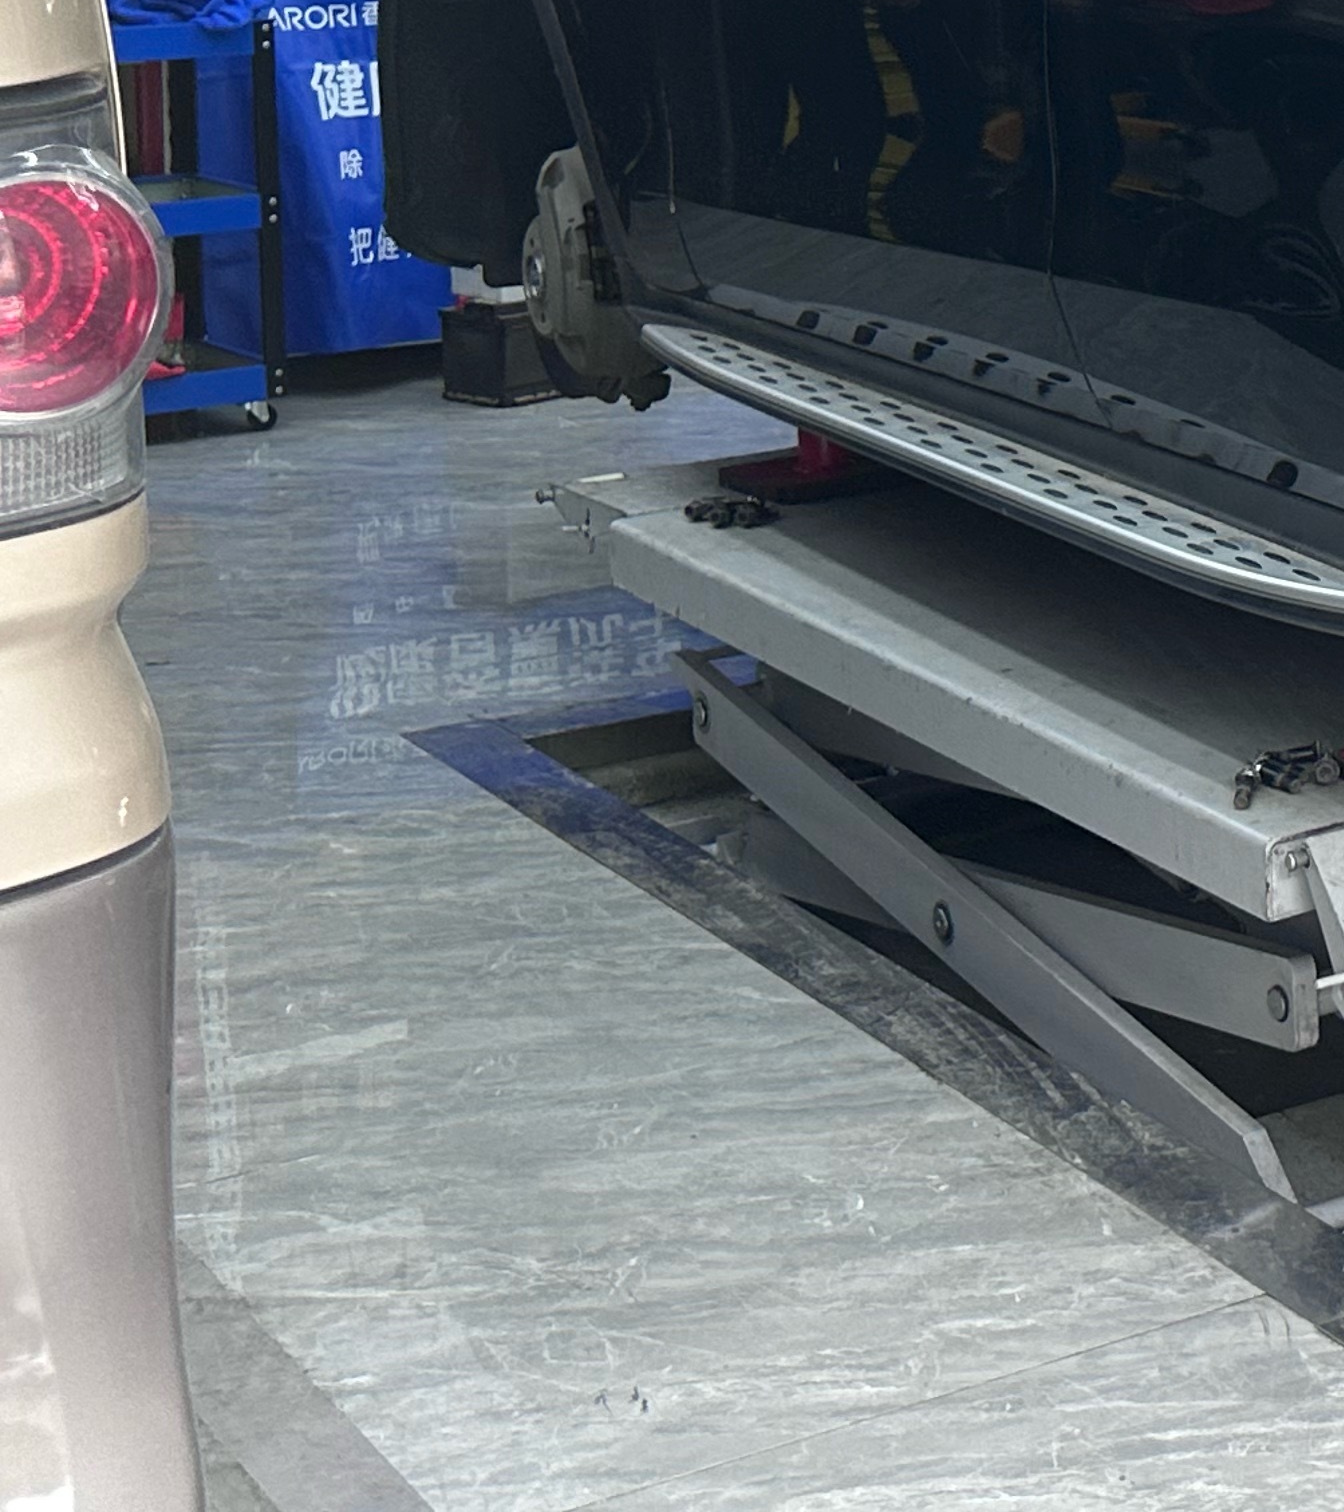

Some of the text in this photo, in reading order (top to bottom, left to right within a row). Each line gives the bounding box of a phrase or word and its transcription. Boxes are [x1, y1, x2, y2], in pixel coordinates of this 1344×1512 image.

[268, 2, 357, 32] ARORI
[310, 59, 381, 121] 健
[338, 148, 363, 180] 除
[348, 224, 412, 266] 把健
